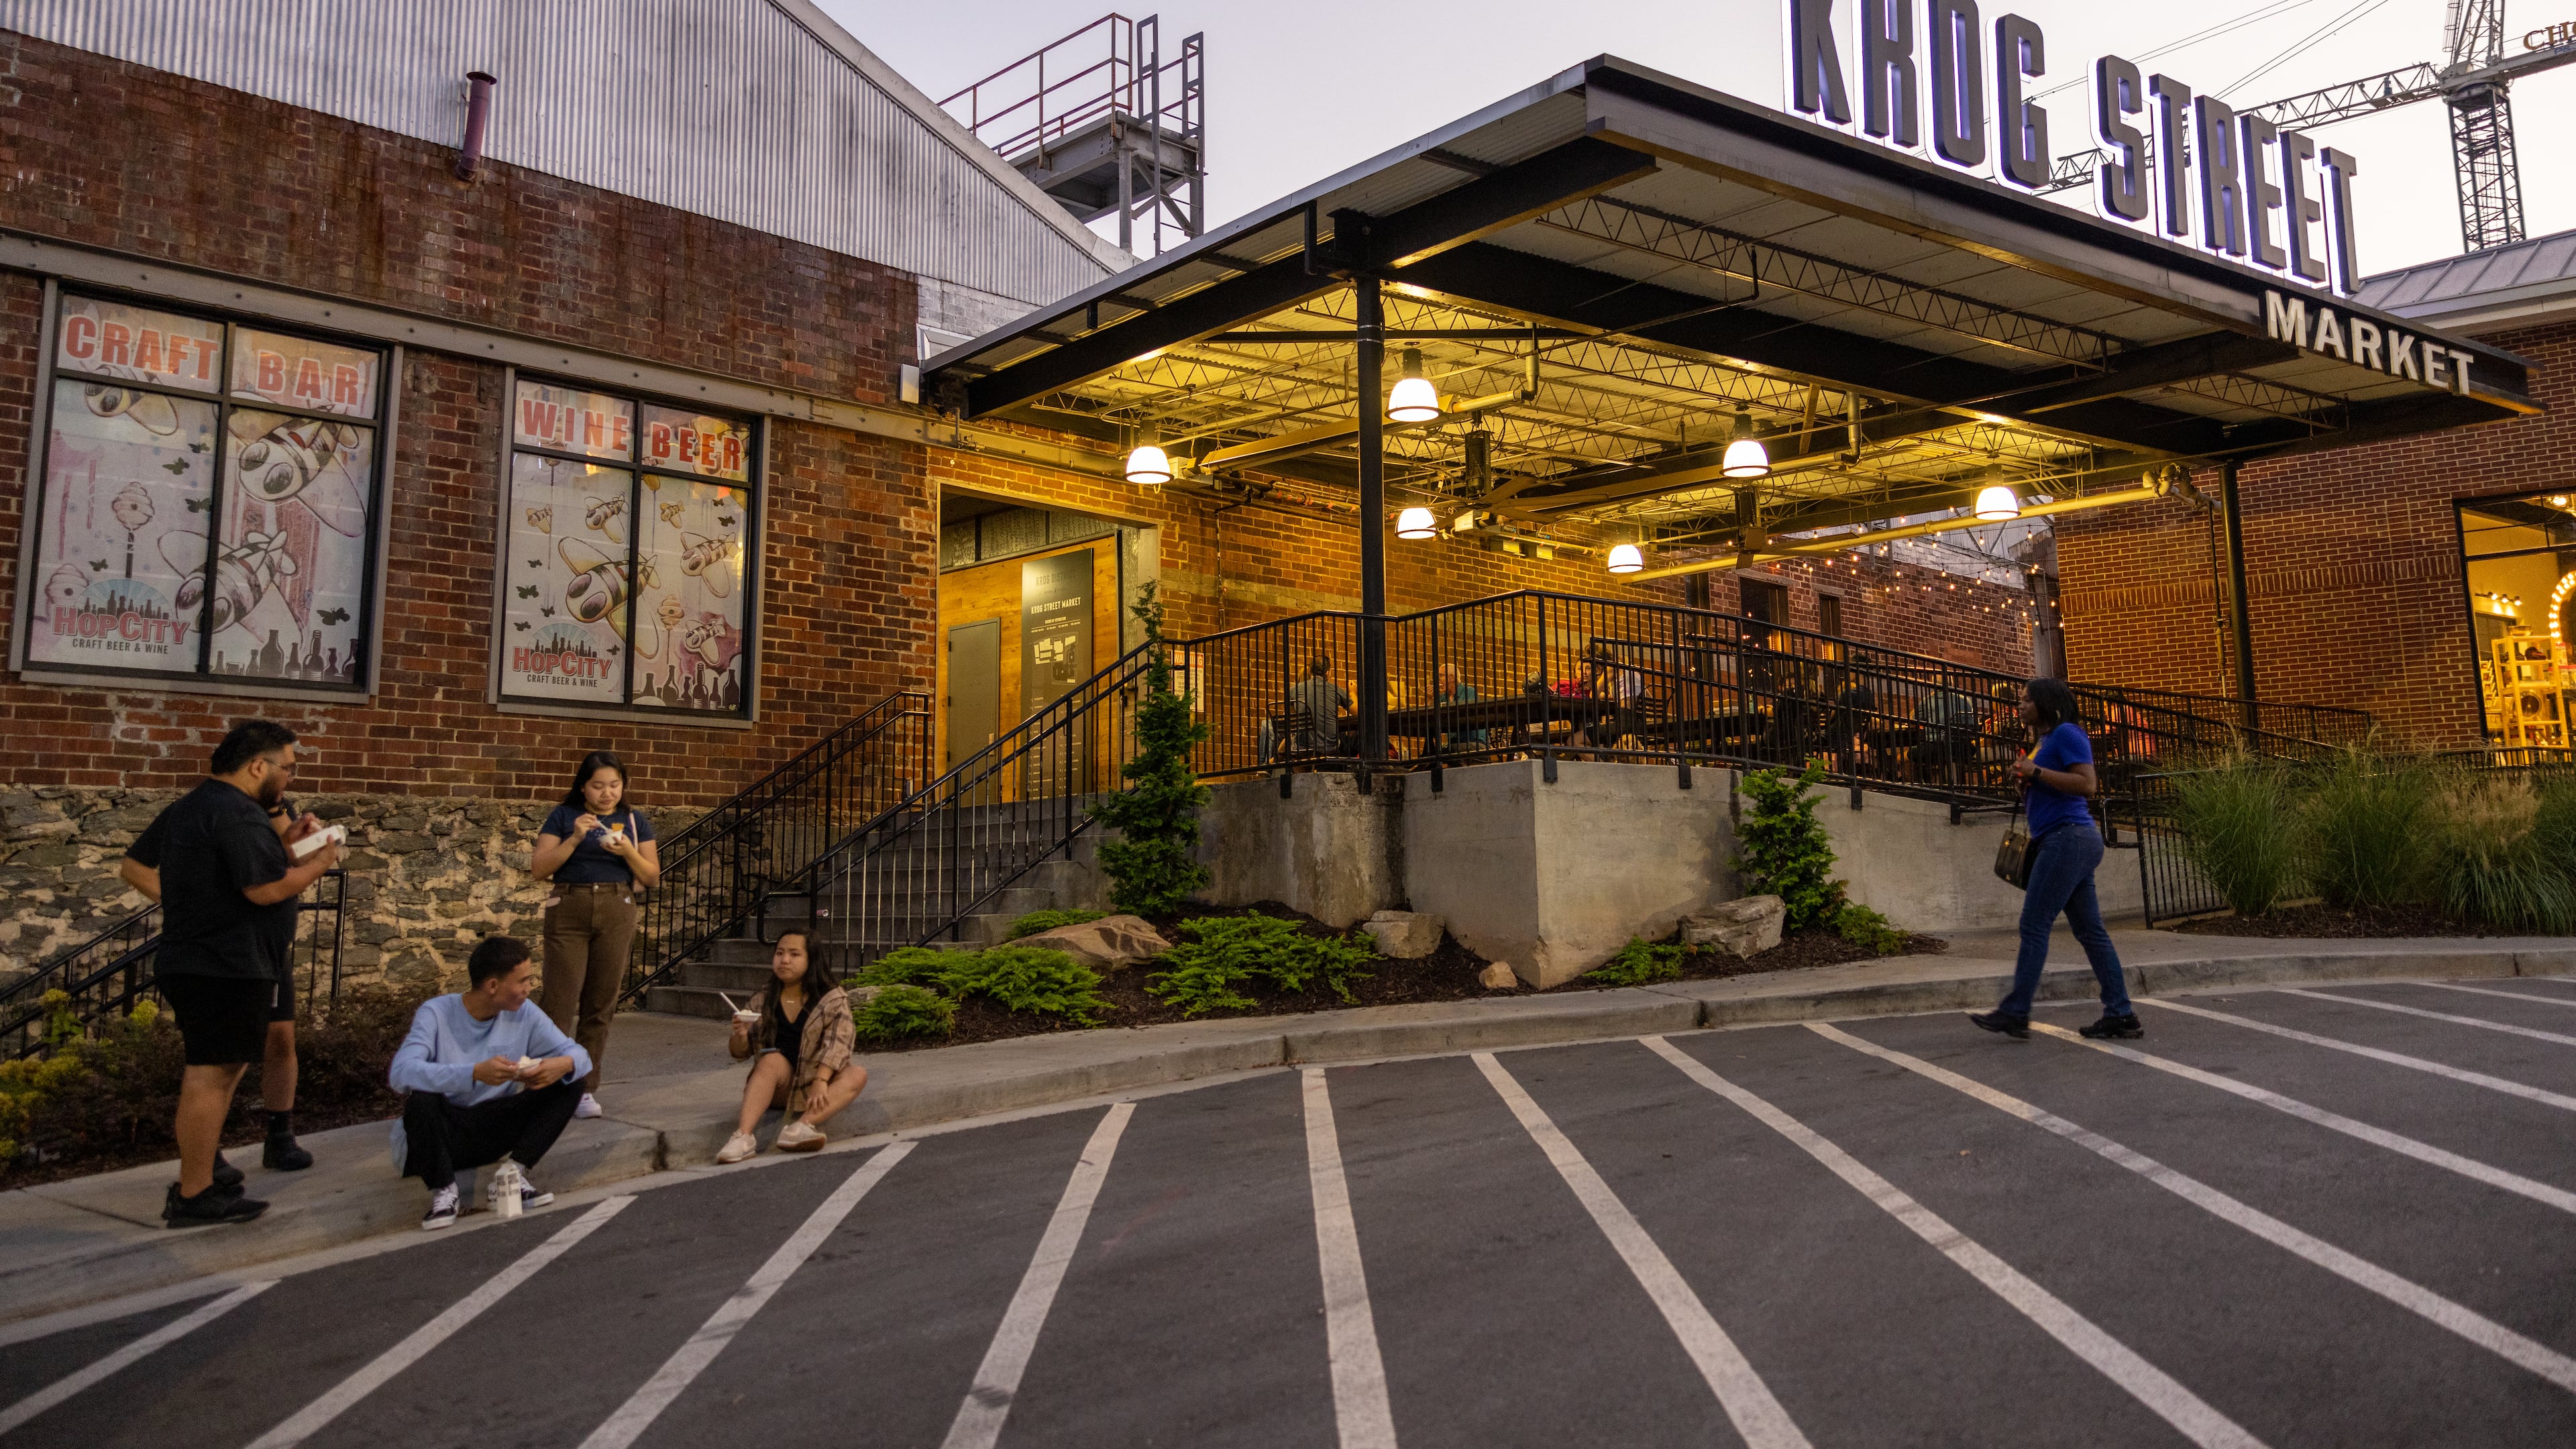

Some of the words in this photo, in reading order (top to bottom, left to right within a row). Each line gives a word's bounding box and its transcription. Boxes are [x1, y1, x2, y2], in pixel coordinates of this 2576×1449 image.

[1790, 0, 2050, 190] KROG
[2094, 54, 2360, 296] STREET
[2265, 289, 2474, 396] MARKET
[66, 315, 219, 380] CRAFT
[257, 351, 360, 406] BAR
[523, 399, 628, 451] WINE
[651, 423, 741, 470] BEER
[1036, 575, 1050, 586] KROG
[1051, 569, 1075, 583] DISTRIC
[1031, 606, 1043, 614] KROG
[1044, 601, 1061, 612] STREET
[1062, 597, 1081, 608] MARKET
[72, 638, 103, 649] CRAFT
[107, 641, 131, 651] BEER
[134, 643, 141, 652] &
[145, 644, 169, 654] WINE
[1173, 653, 1203, 665] WAIG
[527, 674, 550, 684] CRAFT
[552, 676, 570, 686] BEER
[572, 678, 577, 686] &
[580, 678, 598, 688] WINE
